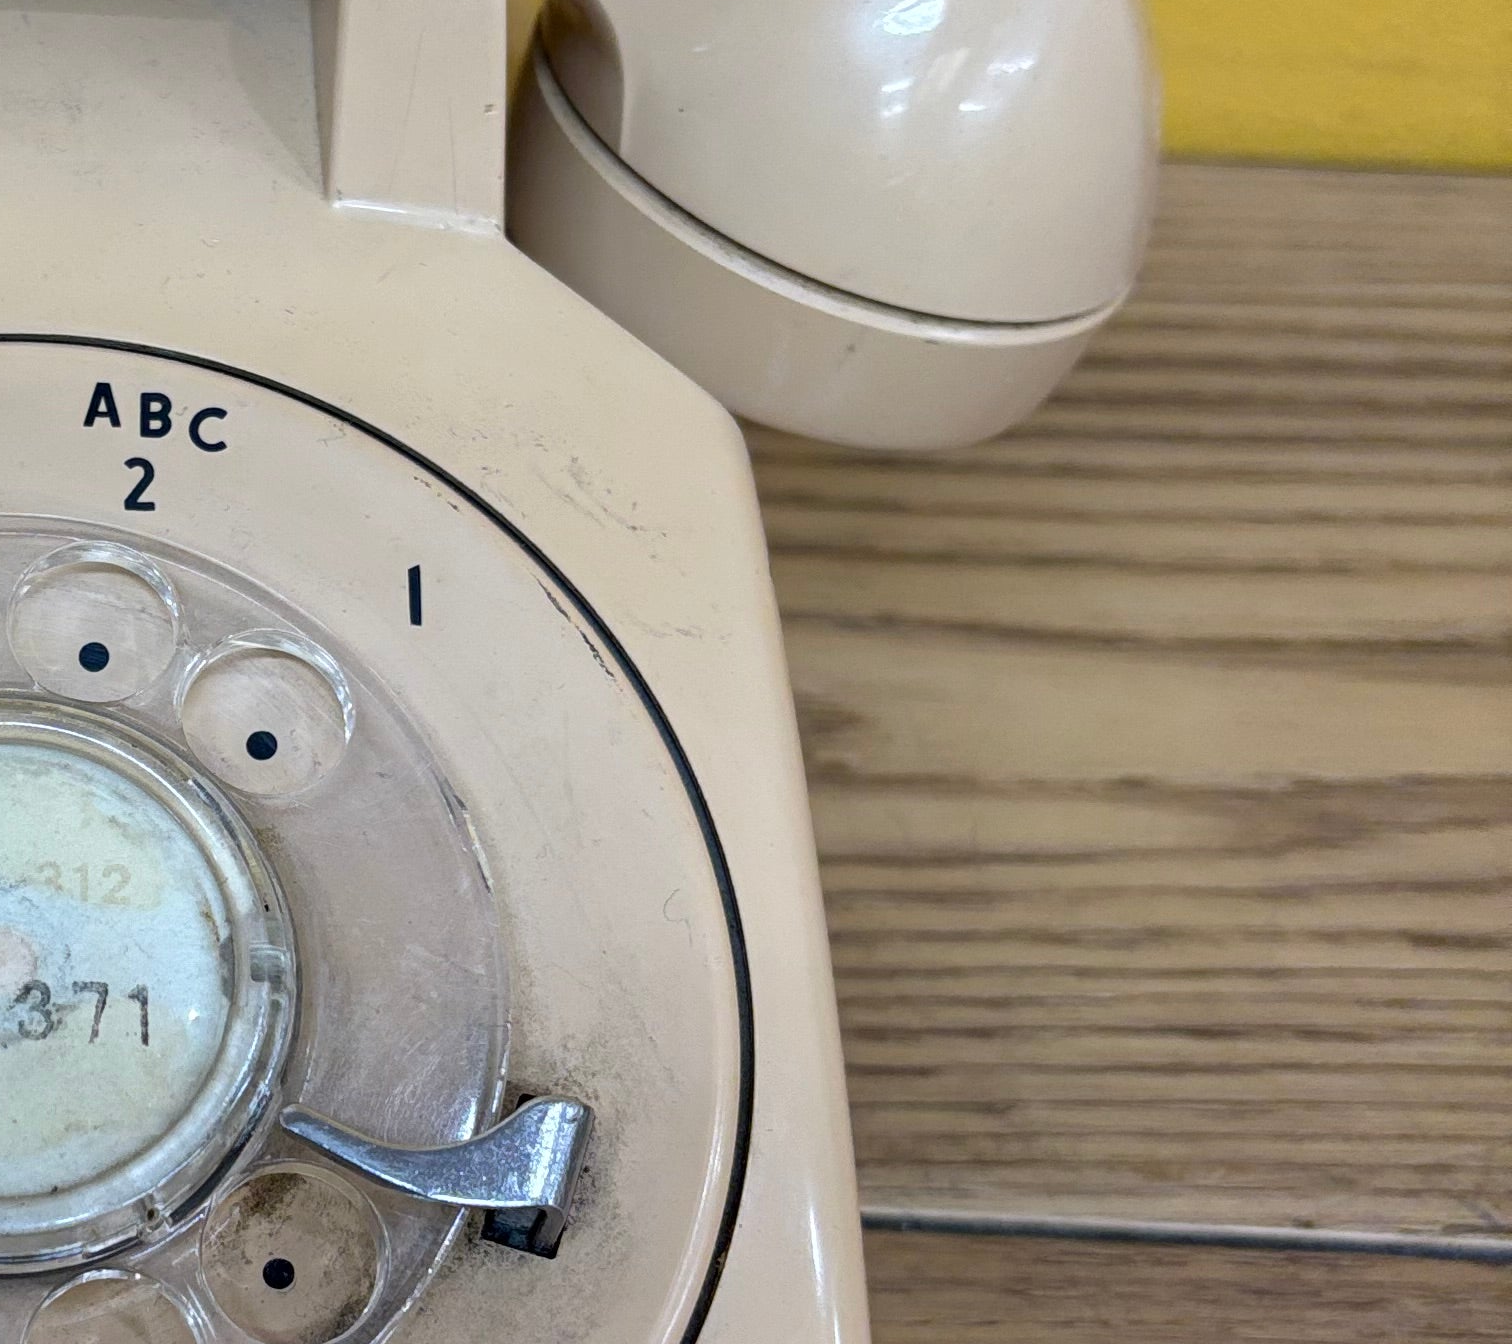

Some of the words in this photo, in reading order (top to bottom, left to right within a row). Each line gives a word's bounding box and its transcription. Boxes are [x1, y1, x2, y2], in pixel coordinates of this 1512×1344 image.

[82, 381, 229, 454] ABC
[123, 456, 157, 513] 2
[34, 859, 133, 907] 312
